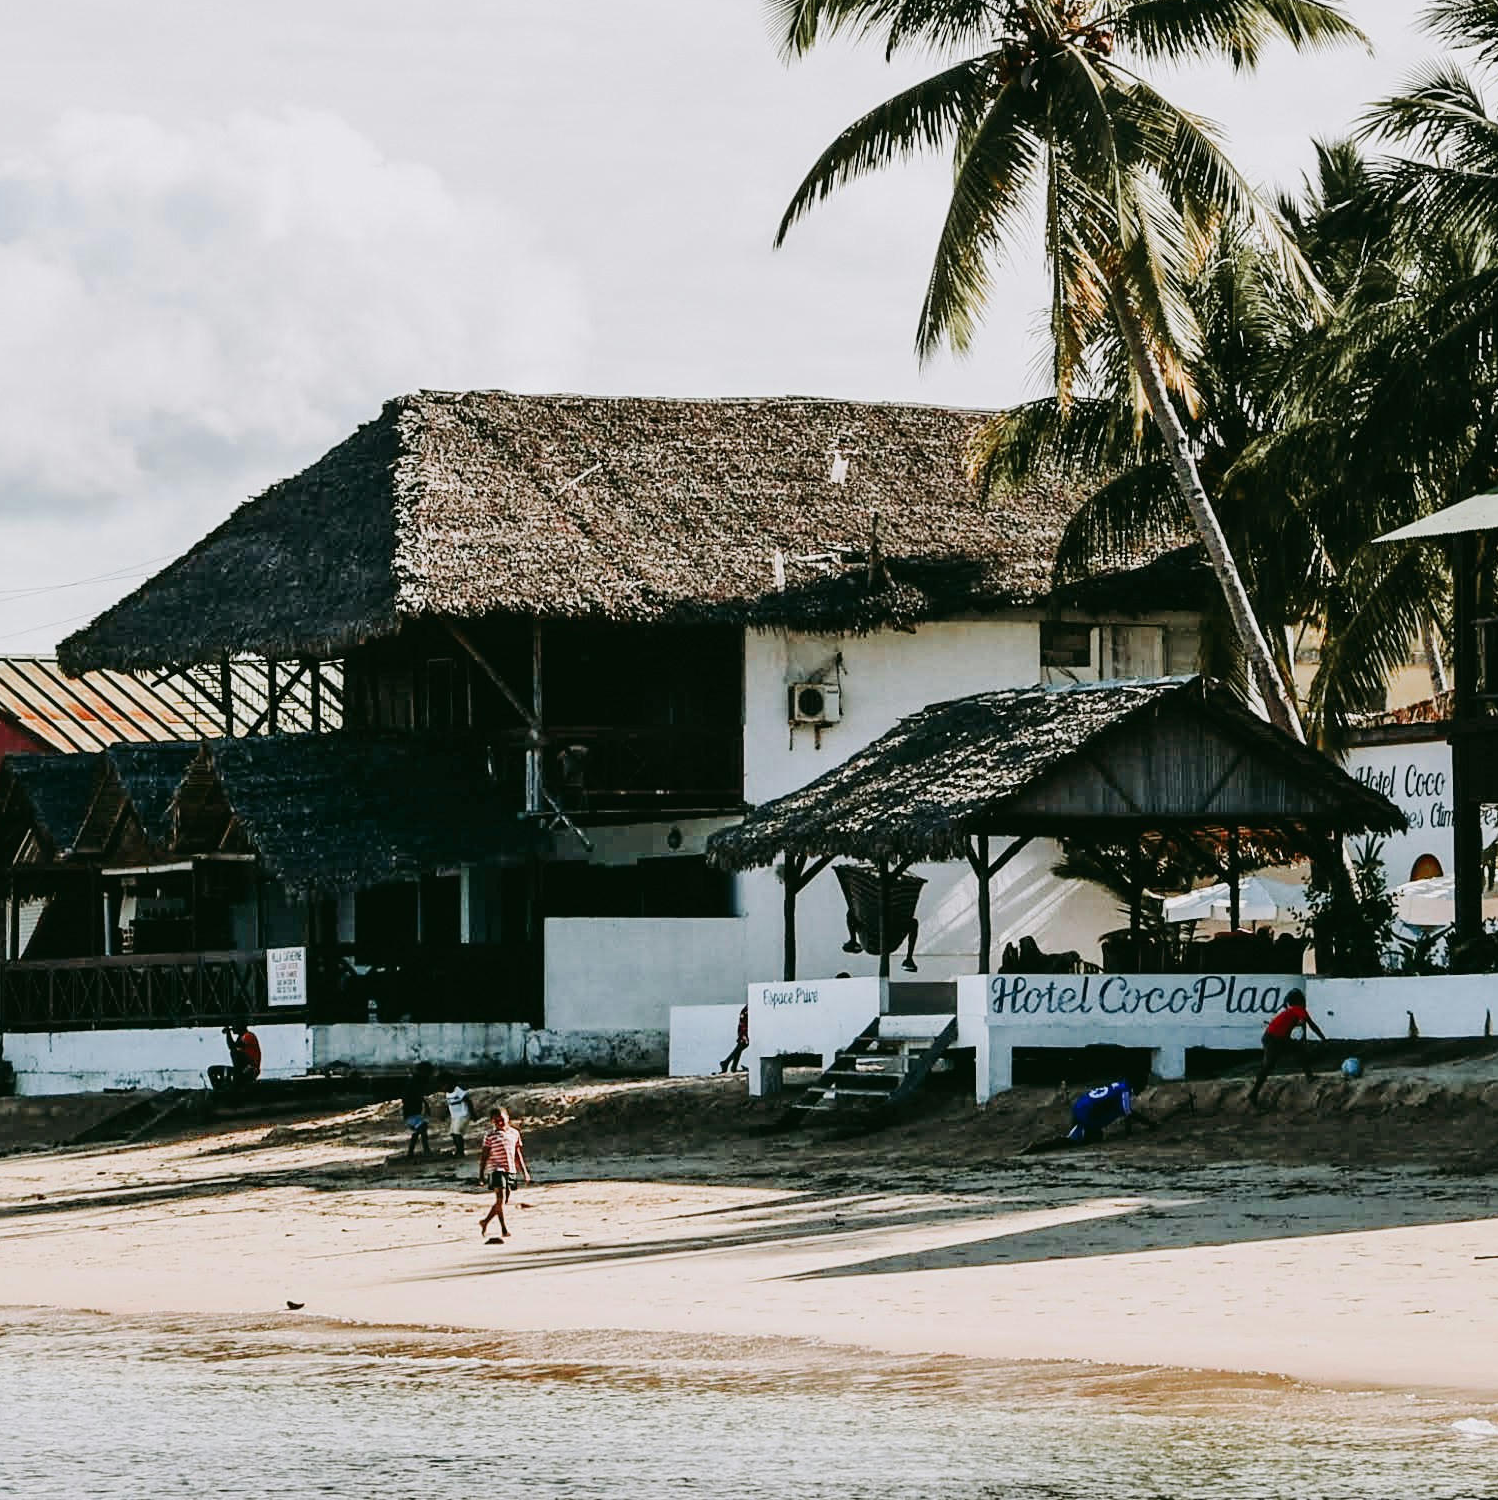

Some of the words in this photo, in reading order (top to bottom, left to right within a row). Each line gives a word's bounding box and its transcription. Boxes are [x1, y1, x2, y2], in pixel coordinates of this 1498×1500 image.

[1356, 766, 1396, 798] Hotel
[1405, 764, 1446, 798] Coco
[763, 989, 793, 1009] Espace
[992, 976, 1092, 1014] Hotel
[1099, 976, 1192, 1014] Coco
[1193, 975, 1291, 1024] Plag
